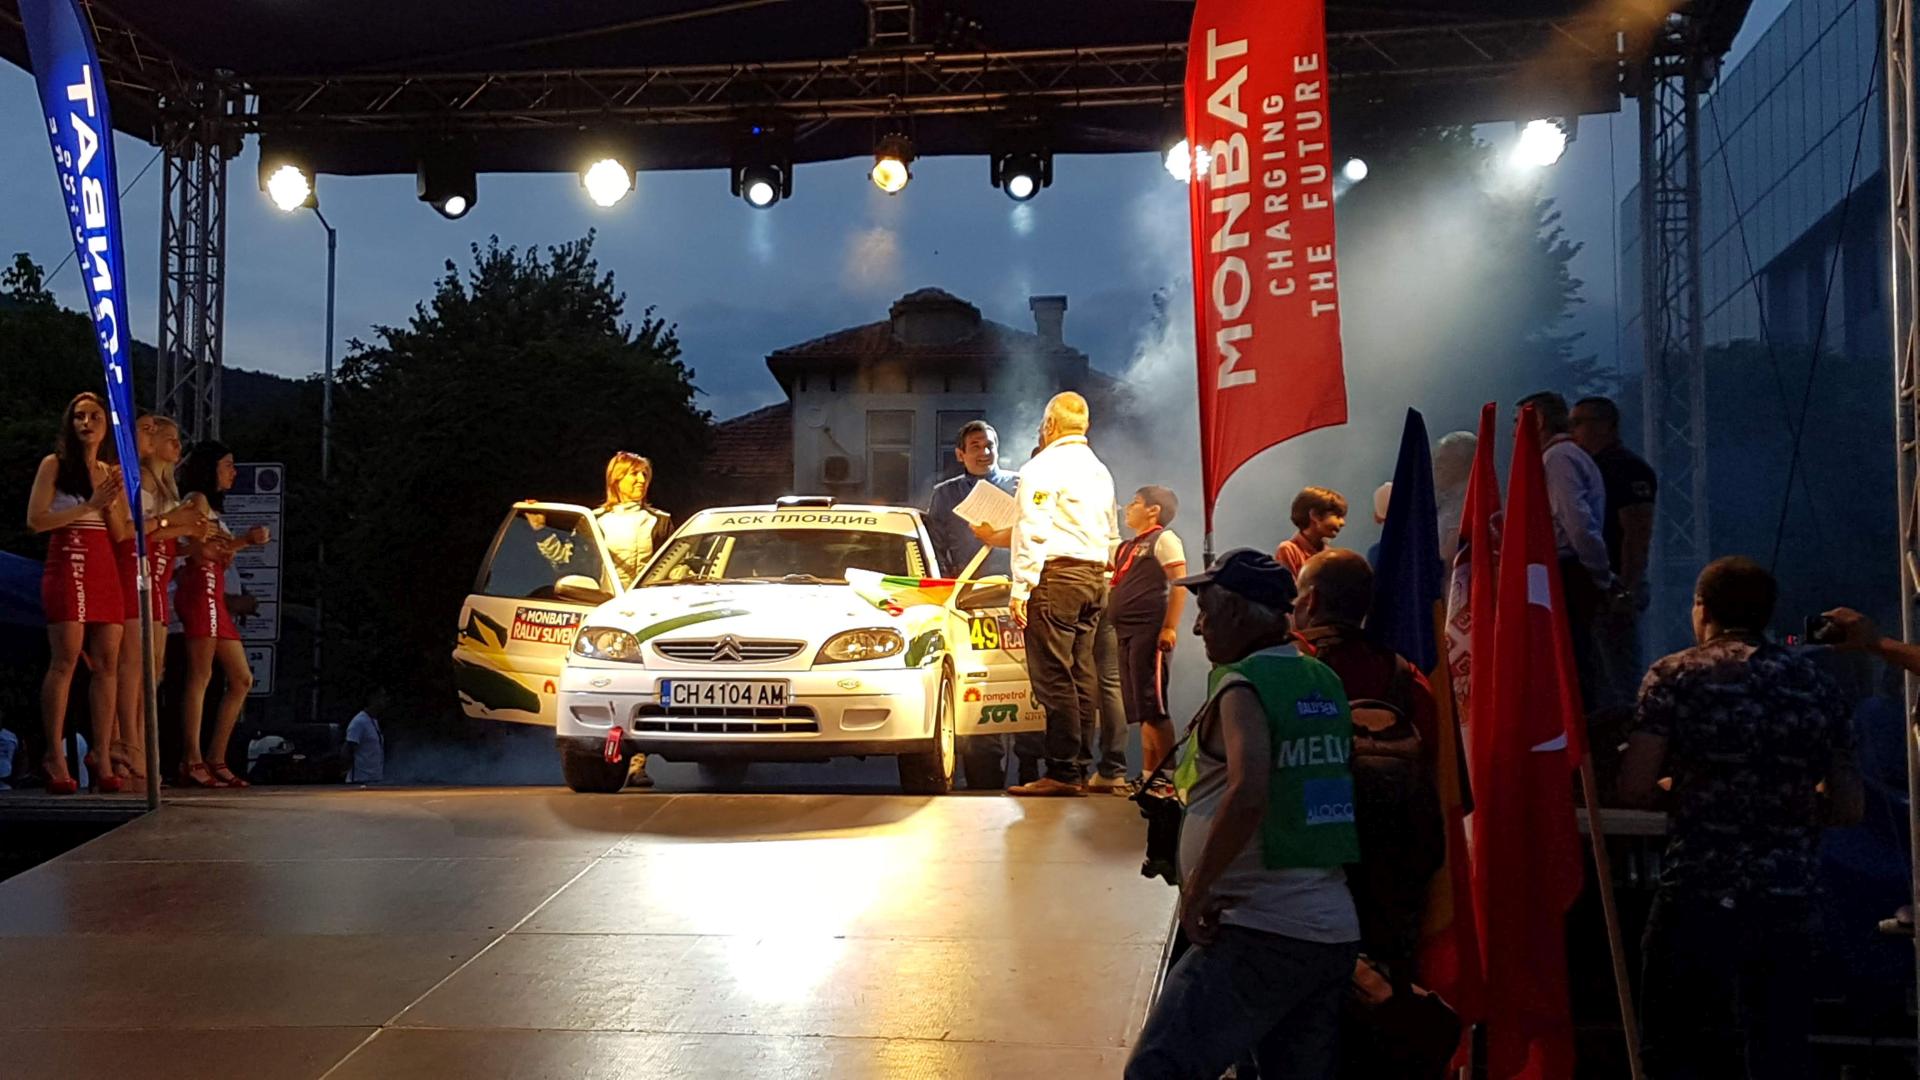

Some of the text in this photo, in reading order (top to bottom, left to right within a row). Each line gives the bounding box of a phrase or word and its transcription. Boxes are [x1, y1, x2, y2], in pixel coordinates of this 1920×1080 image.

[1263, 94, 1295, 297] CHARGING
[1293, 52, 1336, 317] THE FUTURE
[1207, 28, 1257, 390] MONBAT
[722, 513, 878, 526] АСК ПЛОВДИВ
[527, 610, 570, 626] MONBAT
[513, 622, 576, 645] RALLY SLIVEN
[970, 617, 999, 650] 49
[674, 683, 784, 705] CH 4104 AM
[983, 689, 1026, 703] rompetrol
